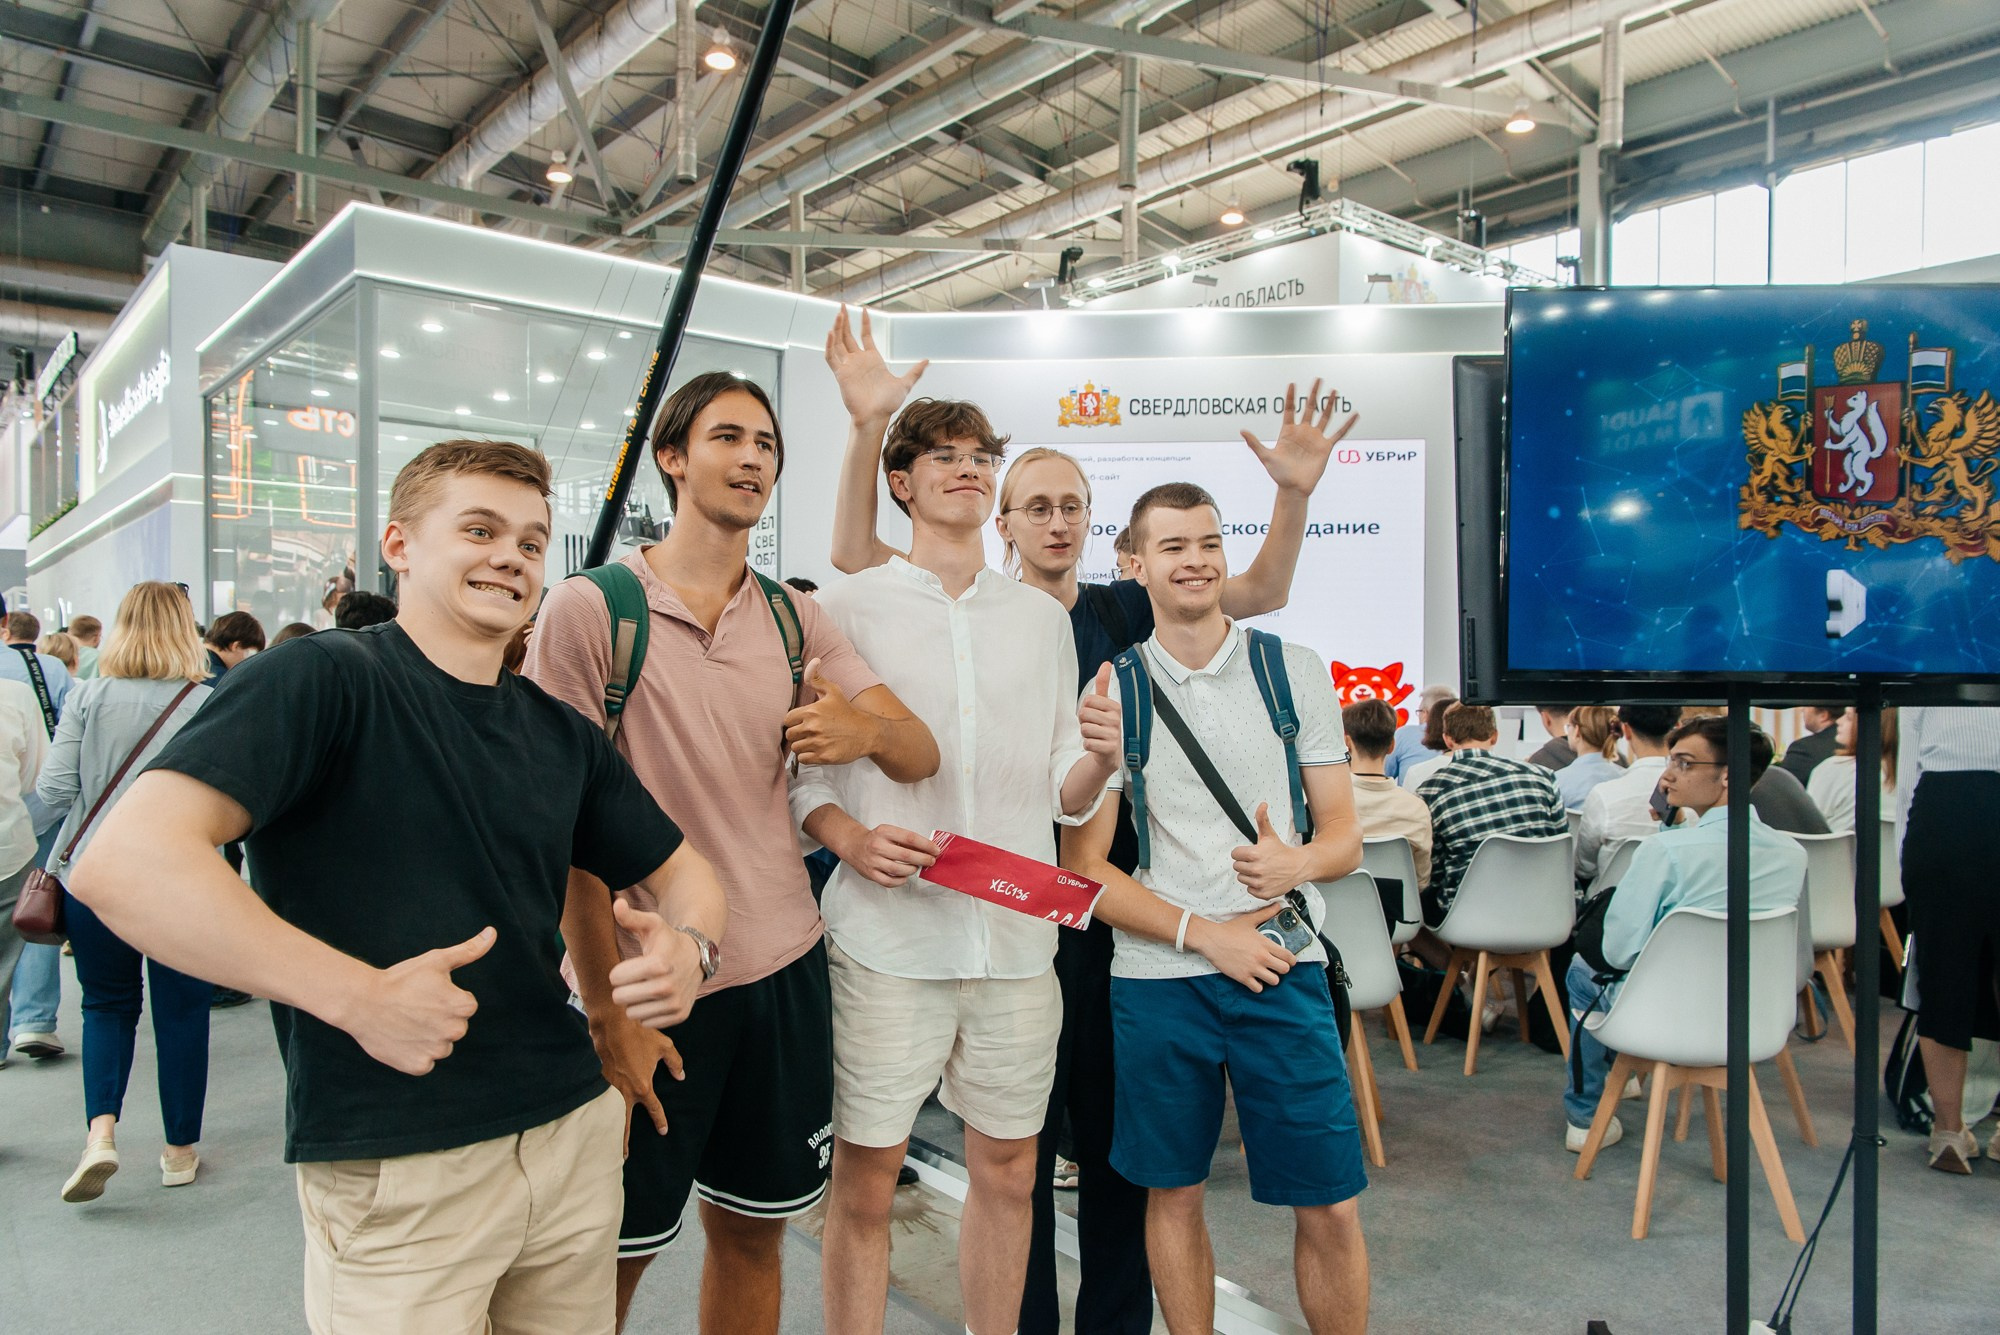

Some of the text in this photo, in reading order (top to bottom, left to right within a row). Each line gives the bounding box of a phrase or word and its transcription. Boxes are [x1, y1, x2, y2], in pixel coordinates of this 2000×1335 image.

[1236, 278, 1304, 307] ОБЛАСТЬ
[1129, 396, 1351, 416] СВЕРДЛОВСКАЯ ОЛСТЬ
[1097, 455, 1144, 463] разработка
[1366, 451, 1417, 462] УБРиР
[1091, 522, 1380, 538] ое ское дание
